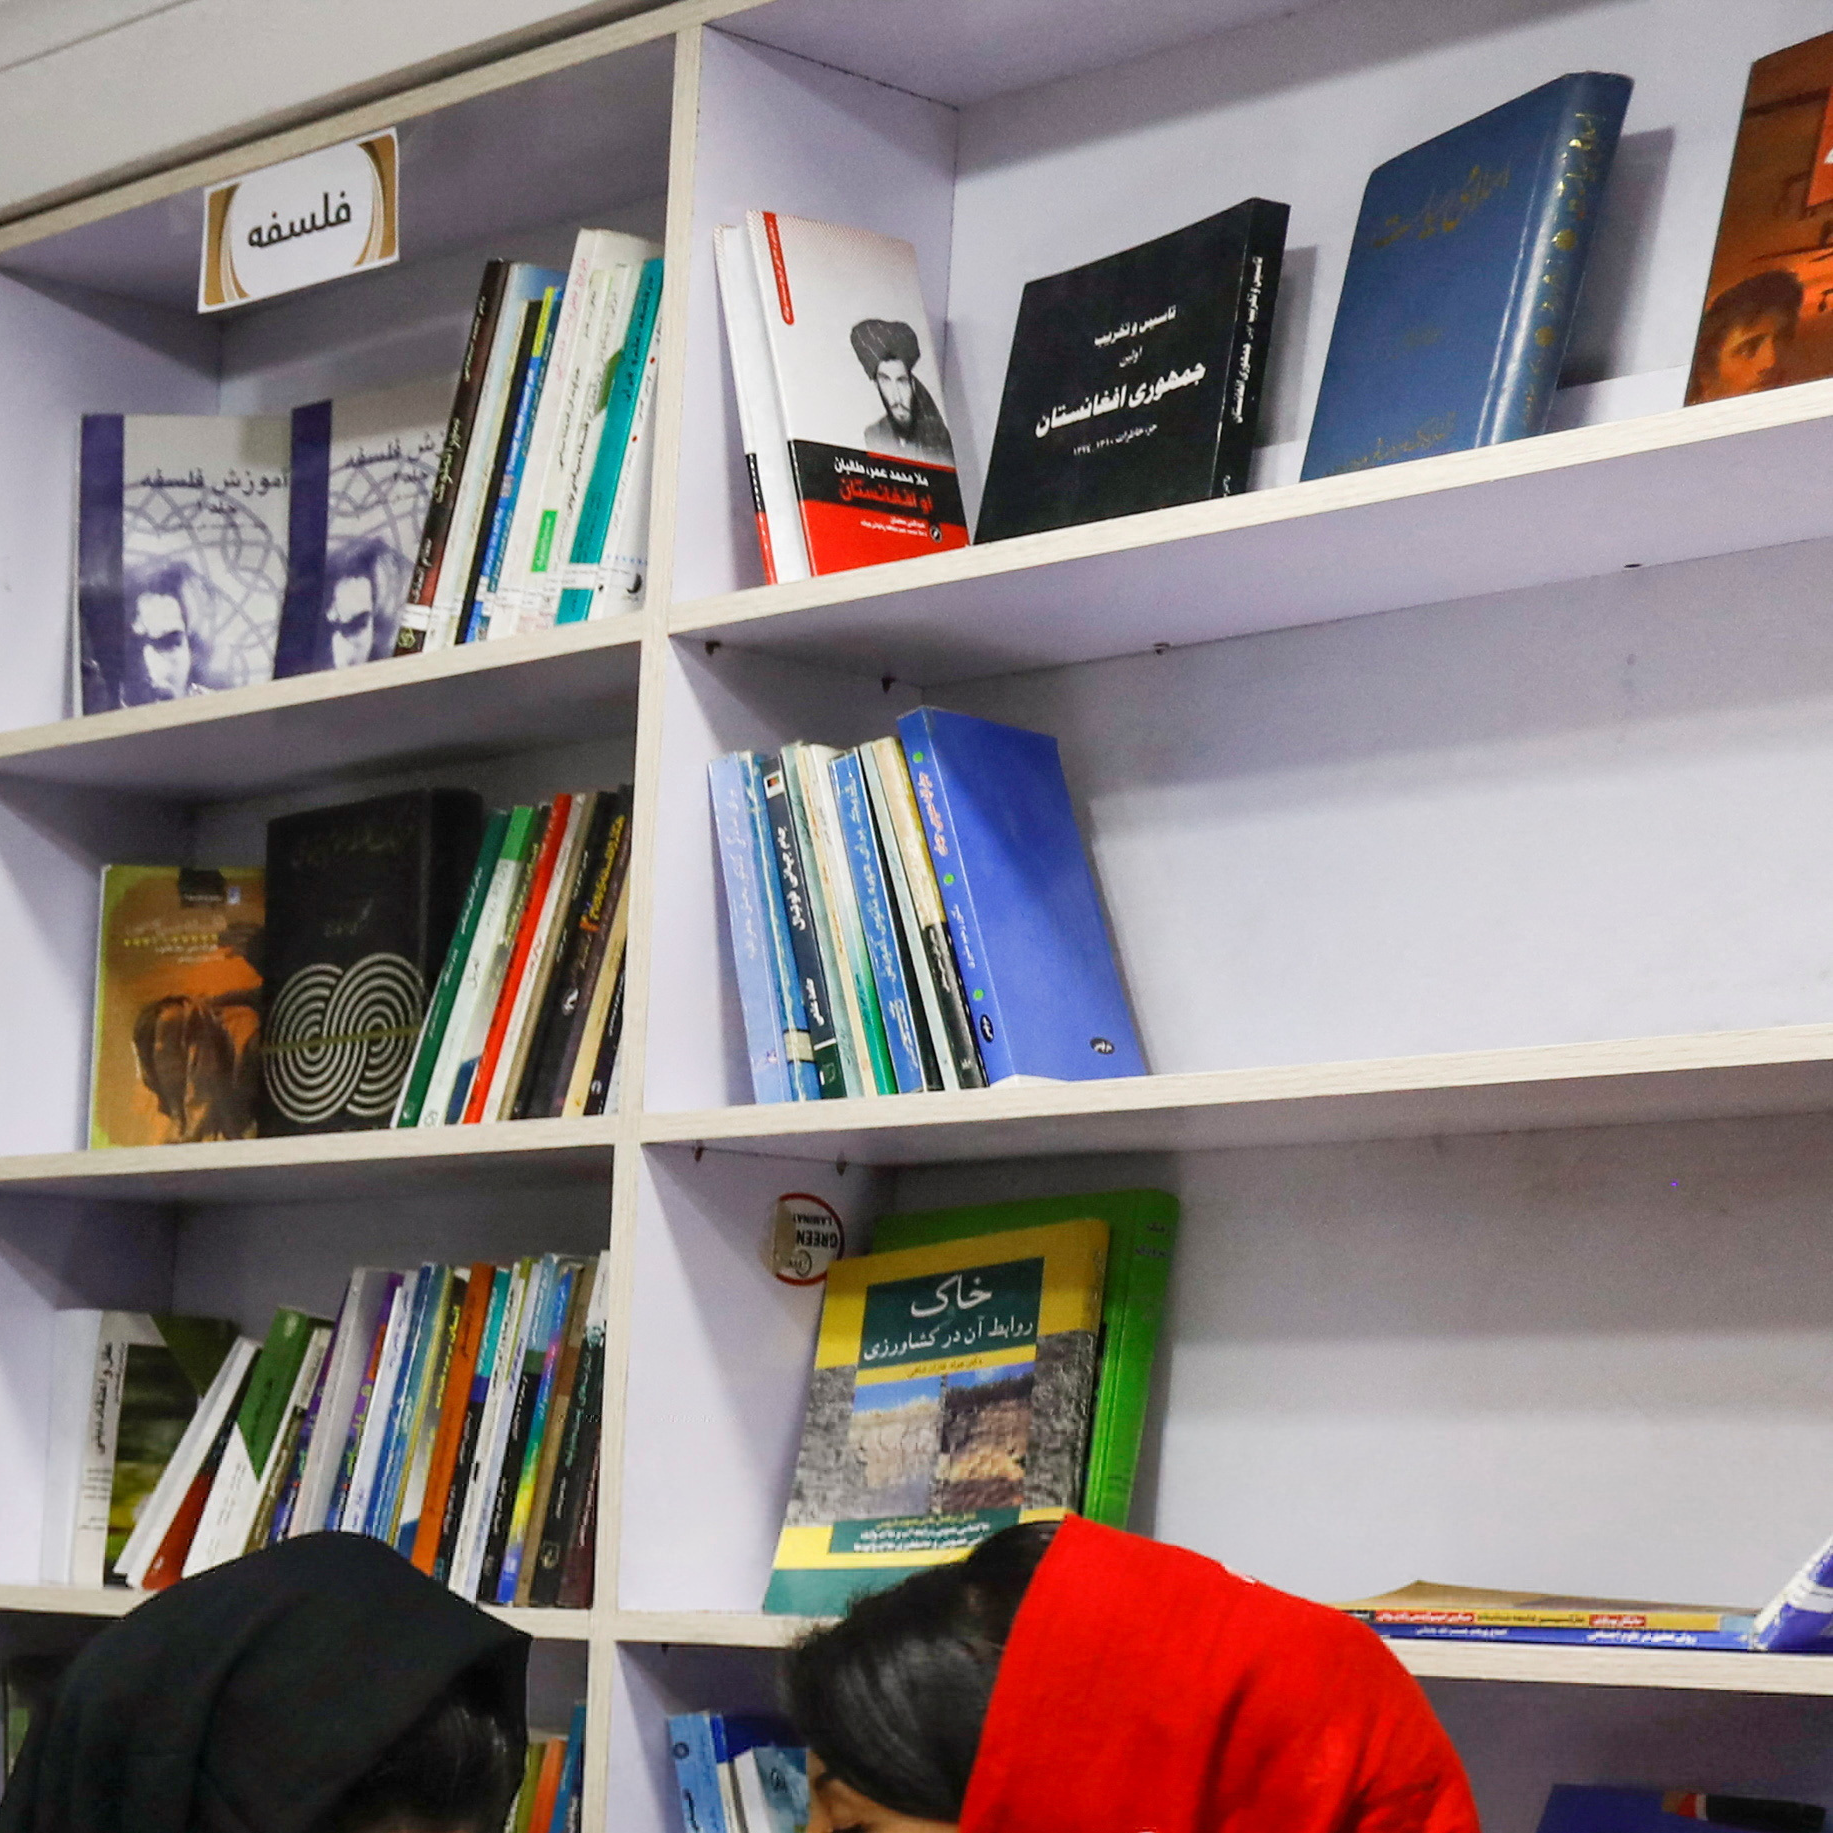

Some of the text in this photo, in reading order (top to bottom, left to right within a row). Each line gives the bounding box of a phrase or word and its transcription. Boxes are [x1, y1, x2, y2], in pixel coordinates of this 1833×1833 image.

[248, 192, 352, 249] فلسفه
[1035, 361, 1206, 439] جمهوری افغانستان
[911, 1272, 992, 1318] خاک
[863, 1314, 1033, 1361] روابط آن در کشاورزی
